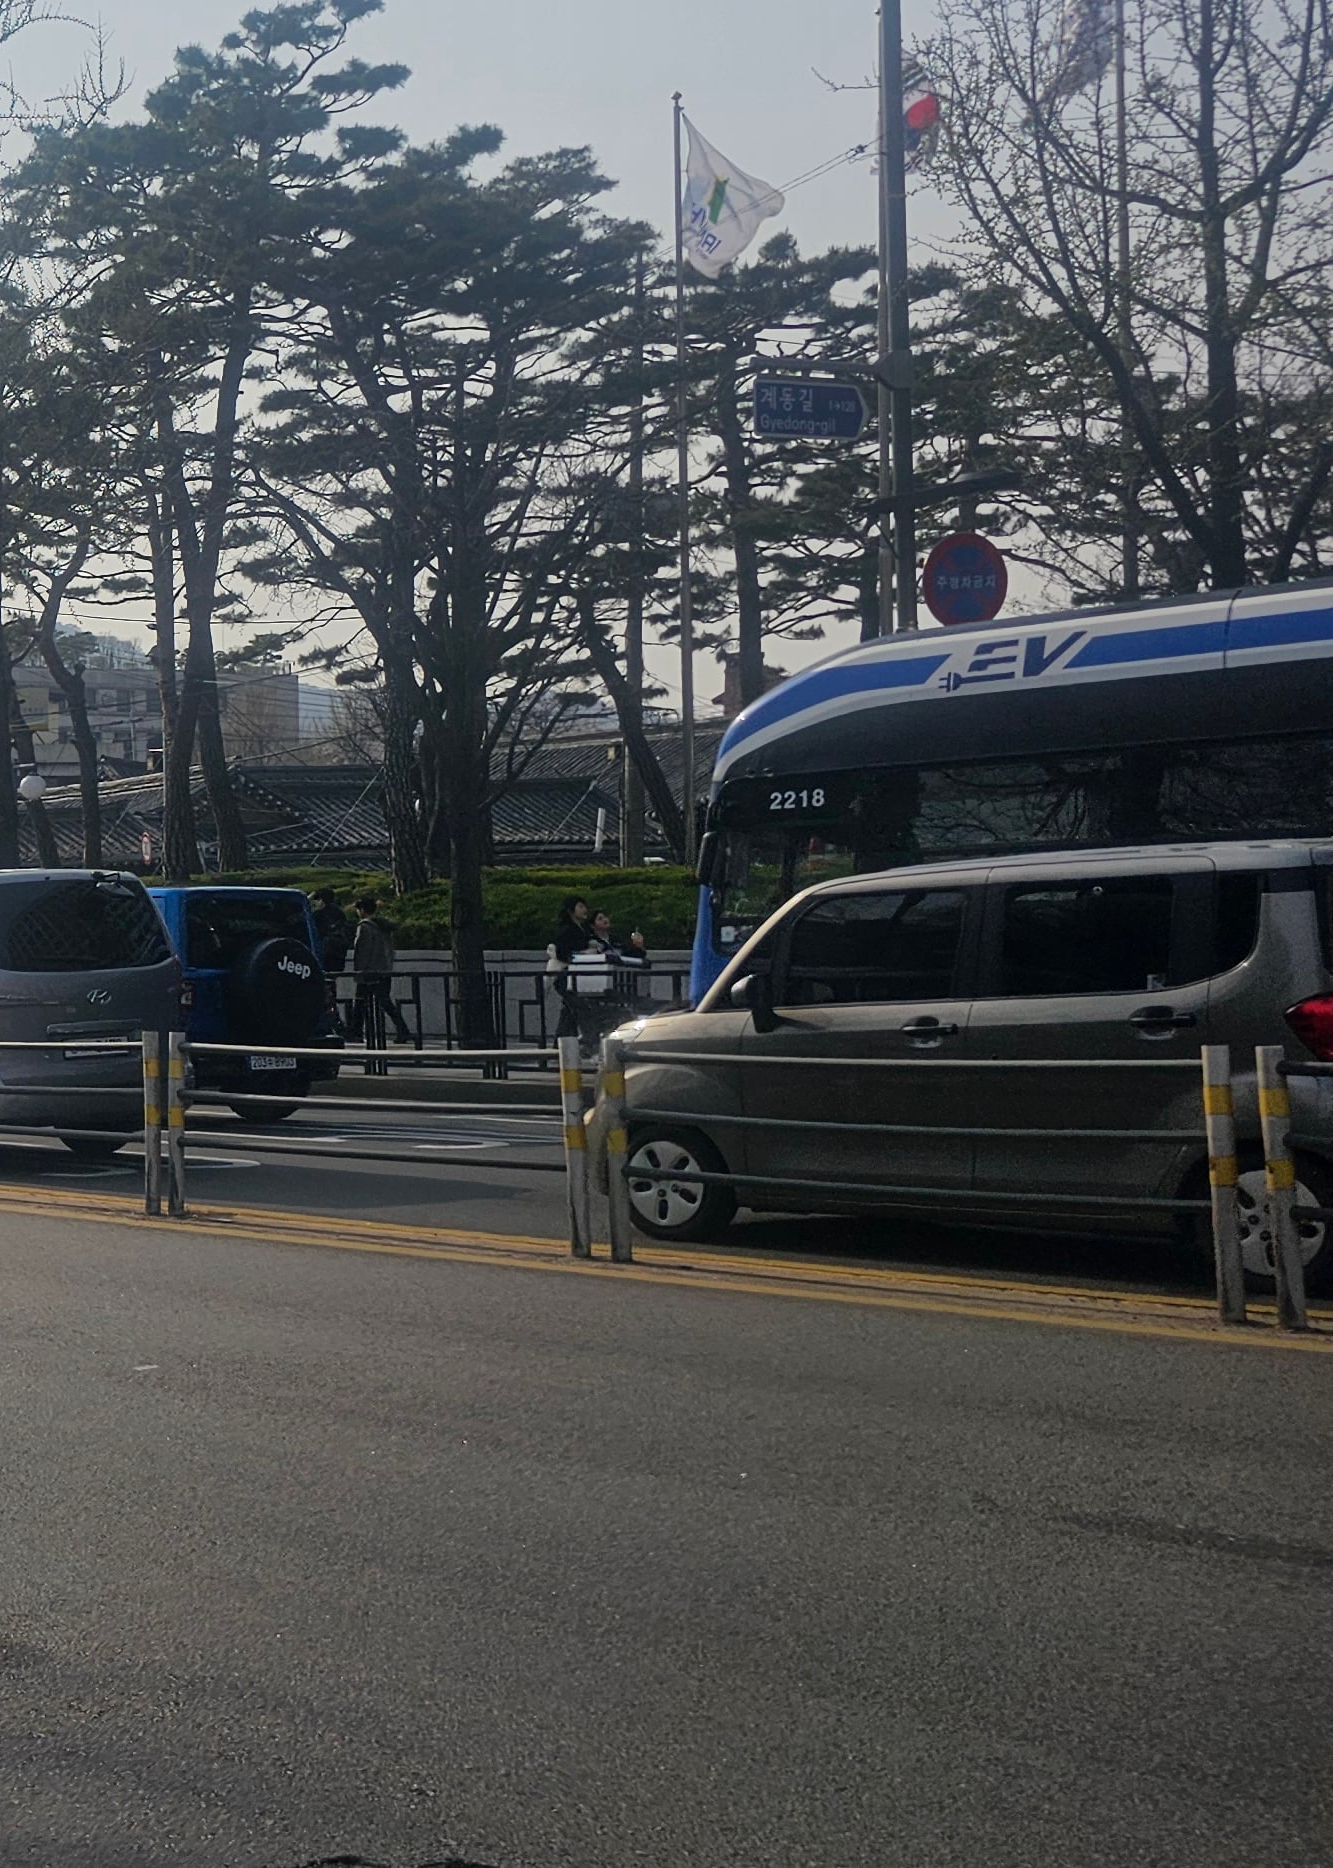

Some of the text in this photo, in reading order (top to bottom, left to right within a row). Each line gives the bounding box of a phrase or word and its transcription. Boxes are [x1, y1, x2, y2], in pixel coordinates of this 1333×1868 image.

[760, 386, 813, 412] 계동길
[761, 414, 836, 433] Gyedong-gil
[936, 575, 997, 590] 주정차금지
[960, 631, 1088, 684] EV
[769, 788, 825, 810] 2218
[277, 955, 311, 979] Jeep
